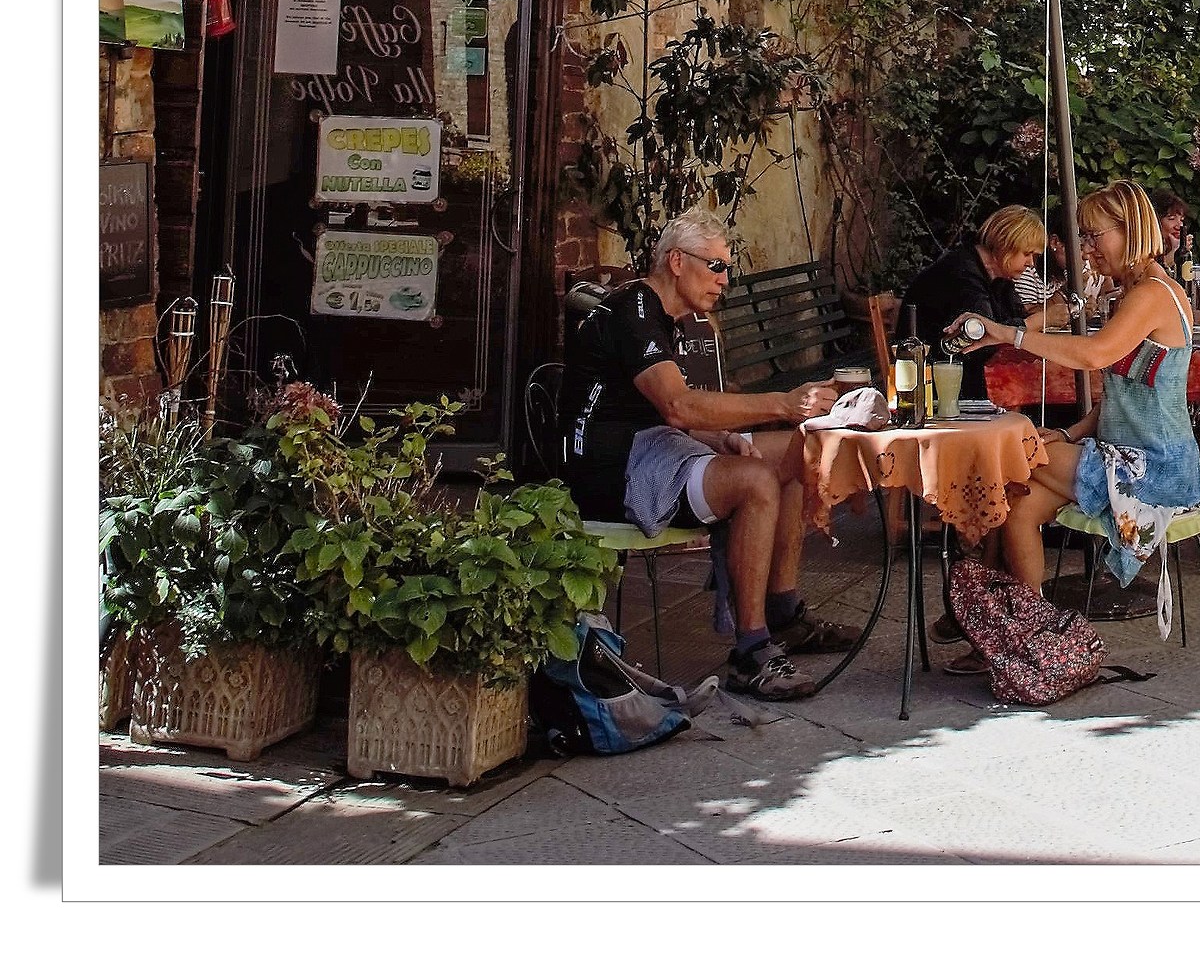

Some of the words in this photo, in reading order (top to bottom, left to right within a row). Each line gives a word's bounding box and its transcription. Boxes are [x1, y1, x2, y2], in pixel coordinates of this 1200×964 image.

[326, 126, 431, 156] CREPES
[347, 153, 382, 171] Con
[321, 175, 407, 193] NUTELLA
[100, 240, 145, 269] PRITZ
[374, 239, 434, 255] SPECIALE
[322, 252, 433, 283] CAPPUCCINO
